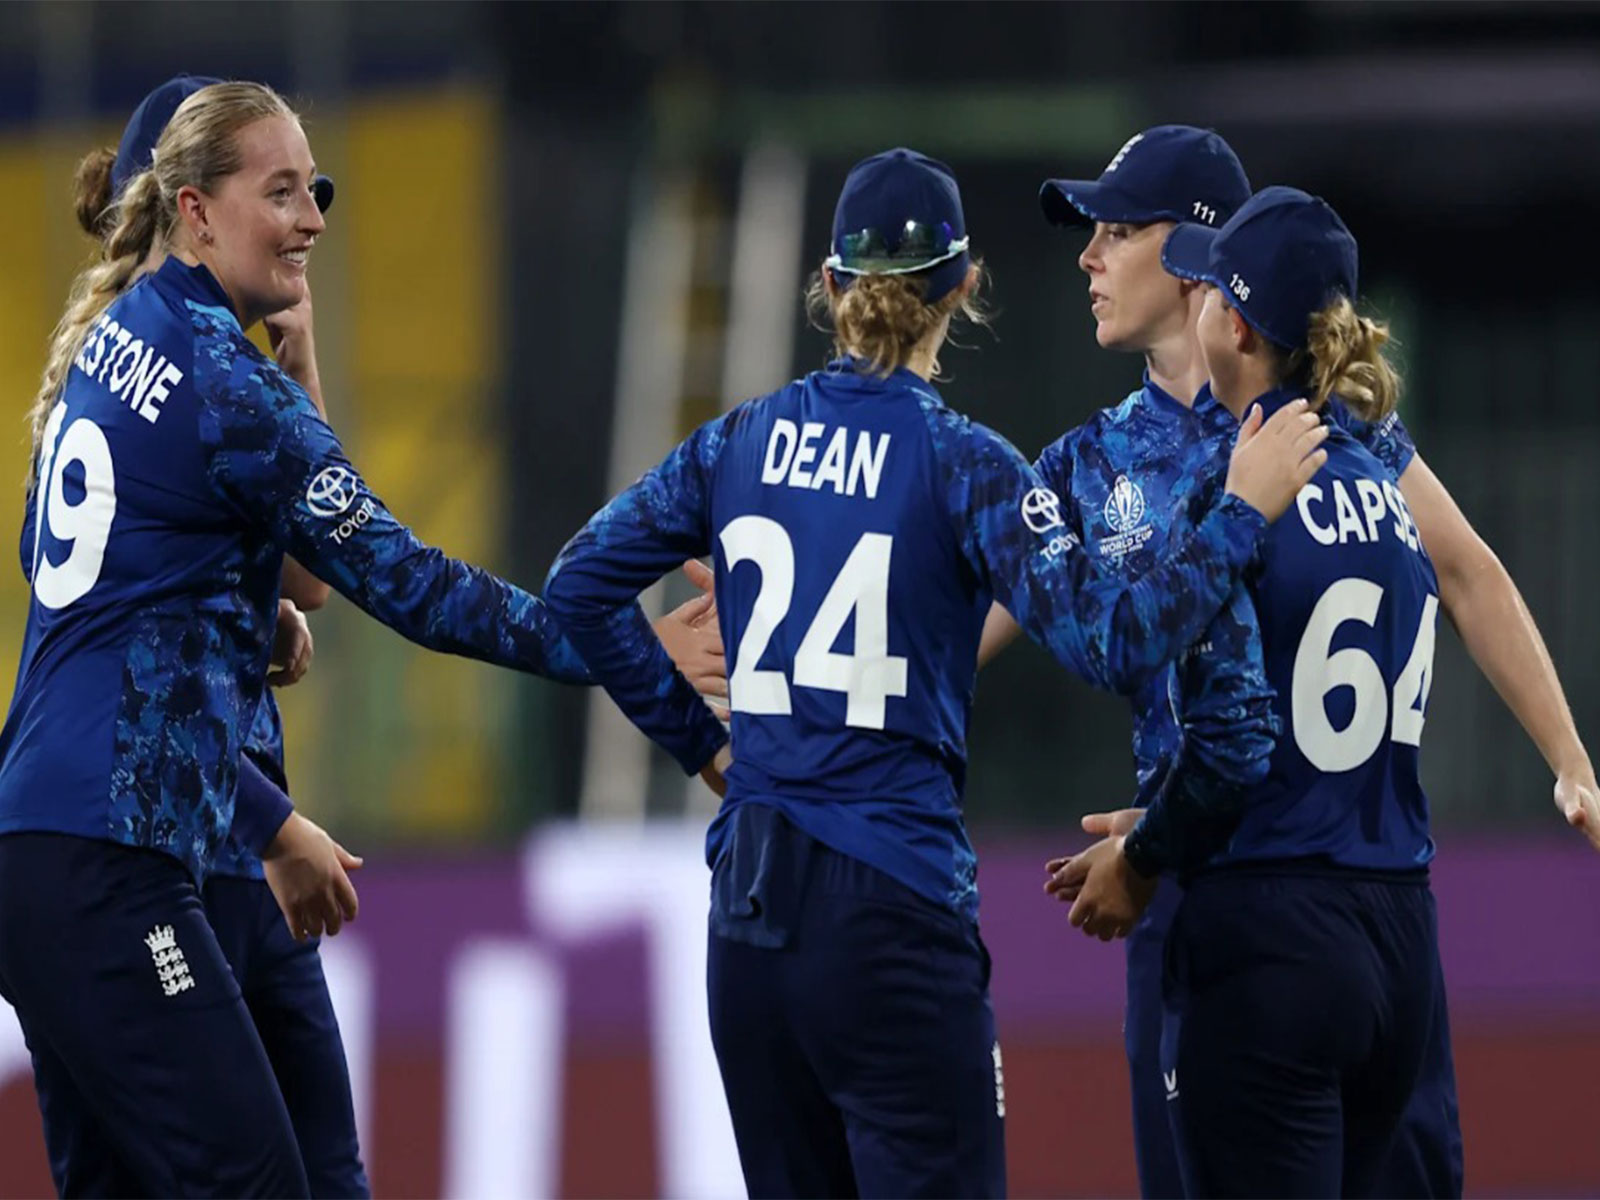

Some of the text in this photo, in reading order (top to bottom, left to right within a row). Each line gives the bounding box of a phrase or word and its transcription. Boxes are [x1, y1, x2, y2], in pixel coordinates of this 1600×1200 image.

[1193, 201, 1216, 224] 111
[1229, 273, 1250, 302] 136
[761, 418, 891, 499] DEAN
[329, 498, 377, 545] TOYOTA
[1100, 537, 1134, 555] WORLD
[1135, 529, 1154, 543] CUP
[718, 515, 908, 730] 24
[1291, 577, 1439, 773] 64
